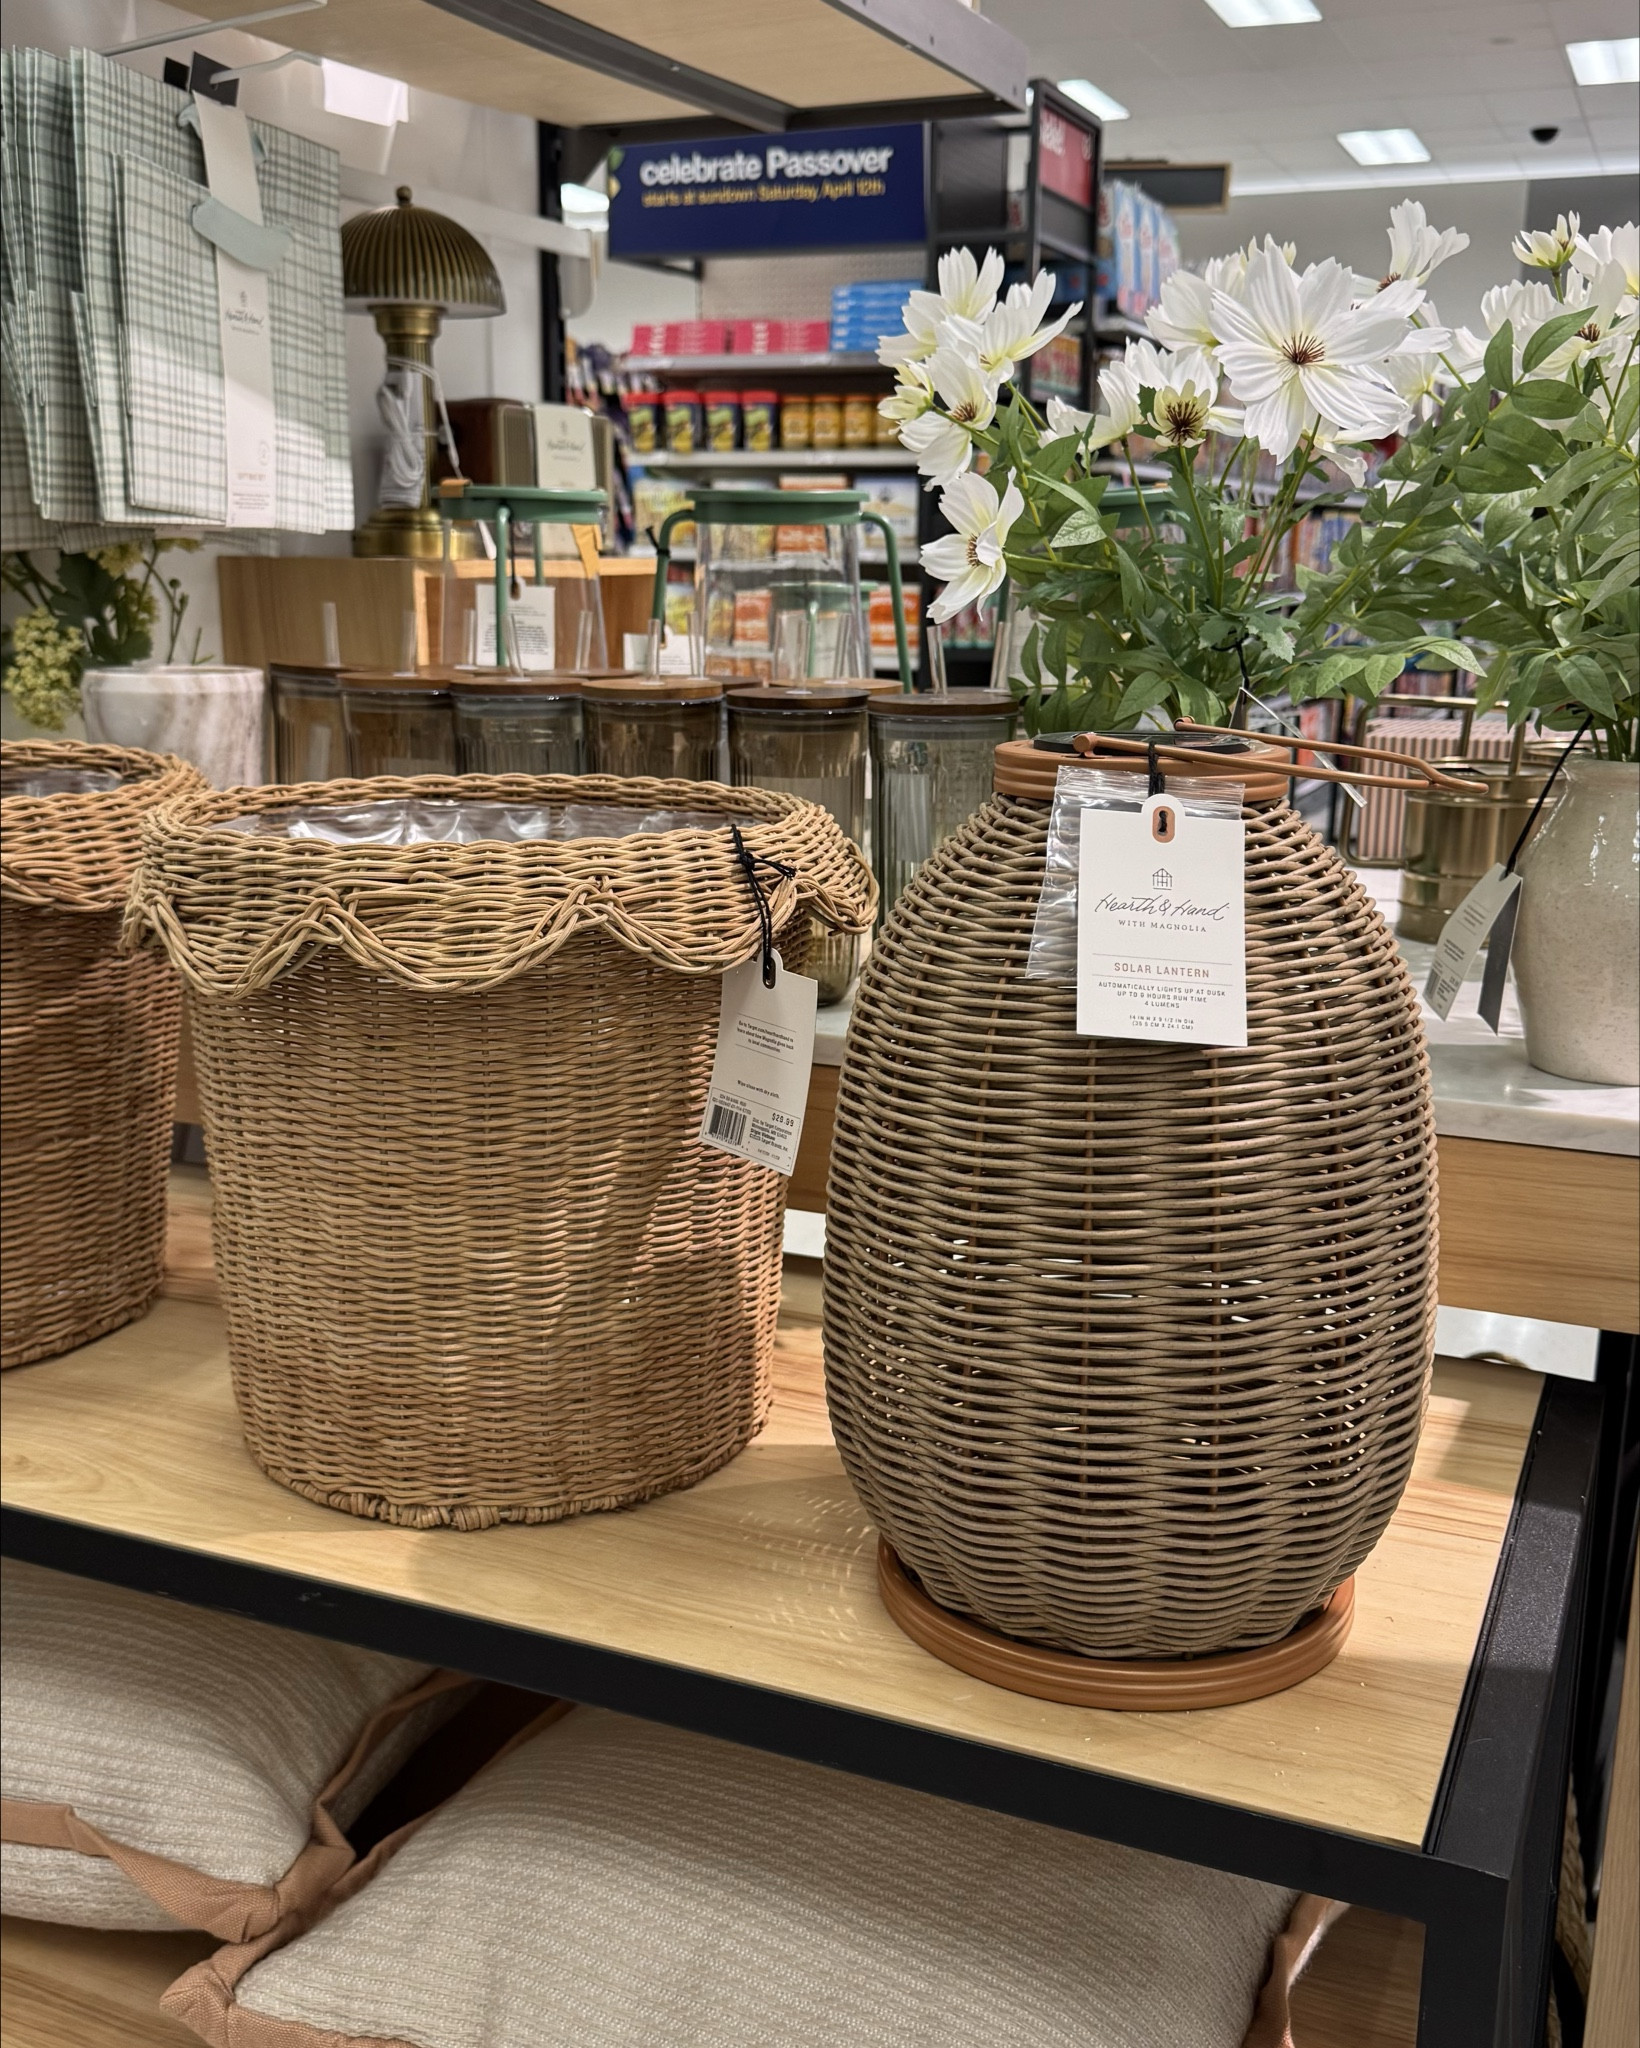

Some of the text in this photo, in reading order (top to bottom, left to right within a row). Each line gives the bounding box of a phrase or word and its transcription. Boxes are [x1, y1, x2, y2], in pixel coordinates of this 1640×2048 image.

[640, 145, 894, 187] celebrate Passover
[820, 178, 853, 201] April
[1095, 893, 1230, 921] Hearth & Hand
[1118, 919, 1207, 932] WITH MAGNOLIA
[1114, 962, 1210, 978] SOLAR LANTERN
[1098, 981, 1155, 991] AUTOMATICALLY
[1157, 986, 1182, 994] LIGHTS
[1207, 989, 1226, 997] DUSK
[1147, 993, 1171, 1001] HOURS
[1151, 1001, 1180, 1009] LUMENS
